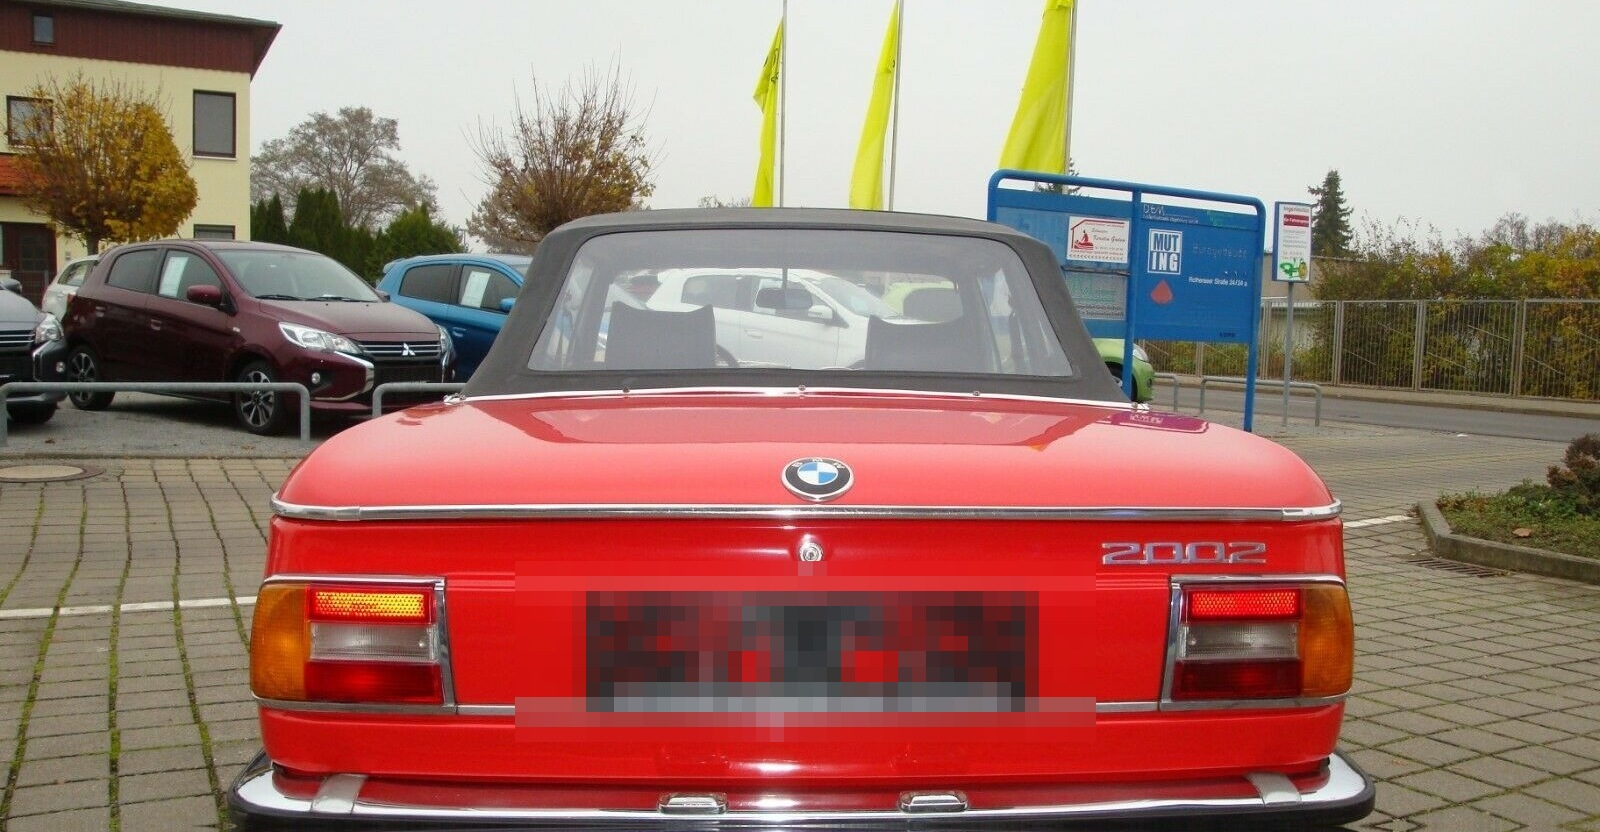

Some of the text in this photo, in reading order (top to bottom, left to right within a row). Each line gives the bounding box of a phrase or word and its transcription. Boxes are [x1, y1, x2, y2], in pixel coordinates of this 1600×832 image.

[1153, 232, 1179, 251] MUT
[1151, 252, 1178, 271] ING
[1102, 542, 1266, 565] 2002
